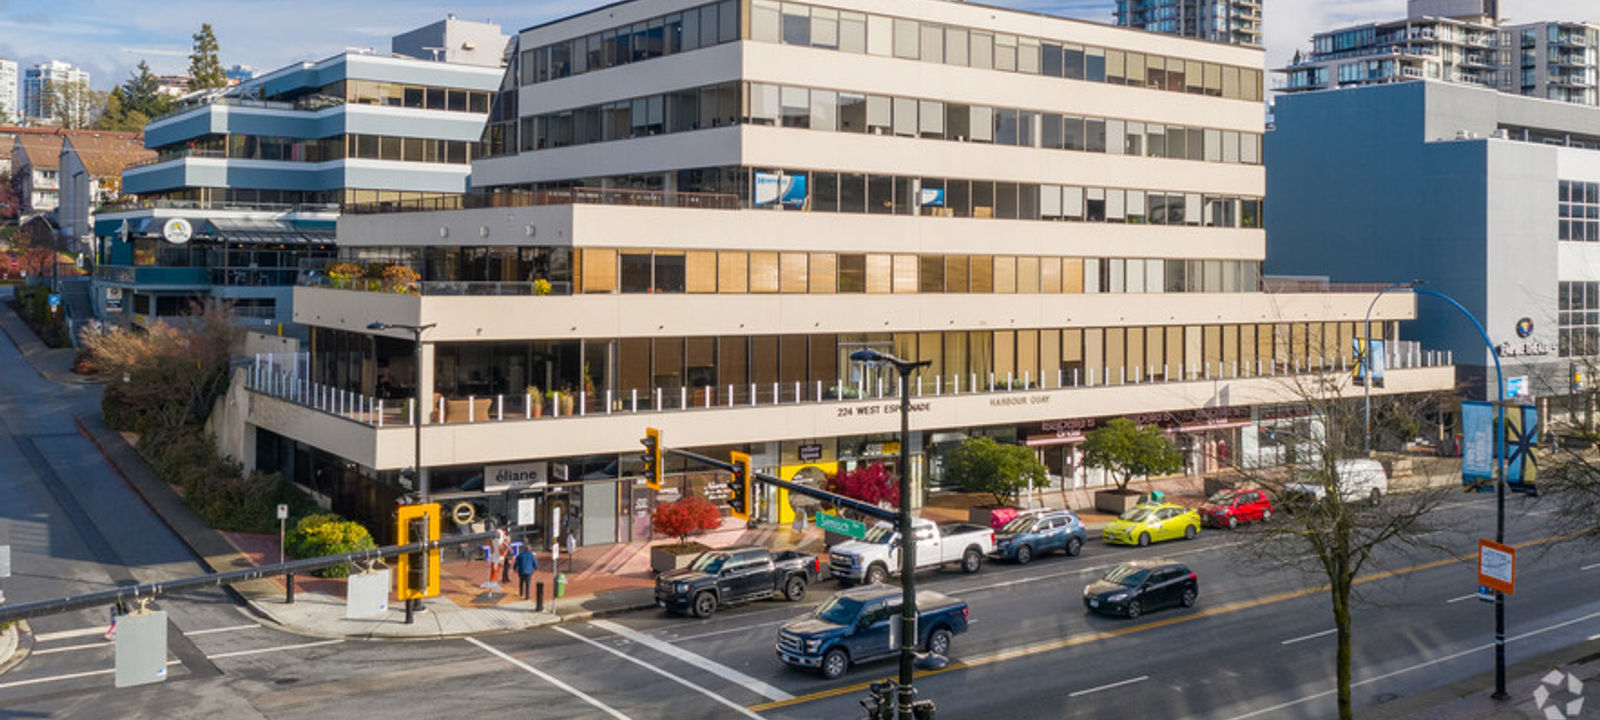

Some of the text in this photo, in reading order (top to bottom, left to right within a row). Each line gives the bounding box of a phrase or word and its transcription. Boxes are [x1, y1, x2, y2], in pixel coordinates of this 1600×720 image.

[989, 395, 1051, 406] HARBOUR QUAY
[856, 404, 881, 416] WEST
[884, 402, 931, 415] ESPNADE
[496, 468, 537, 483] éliane
